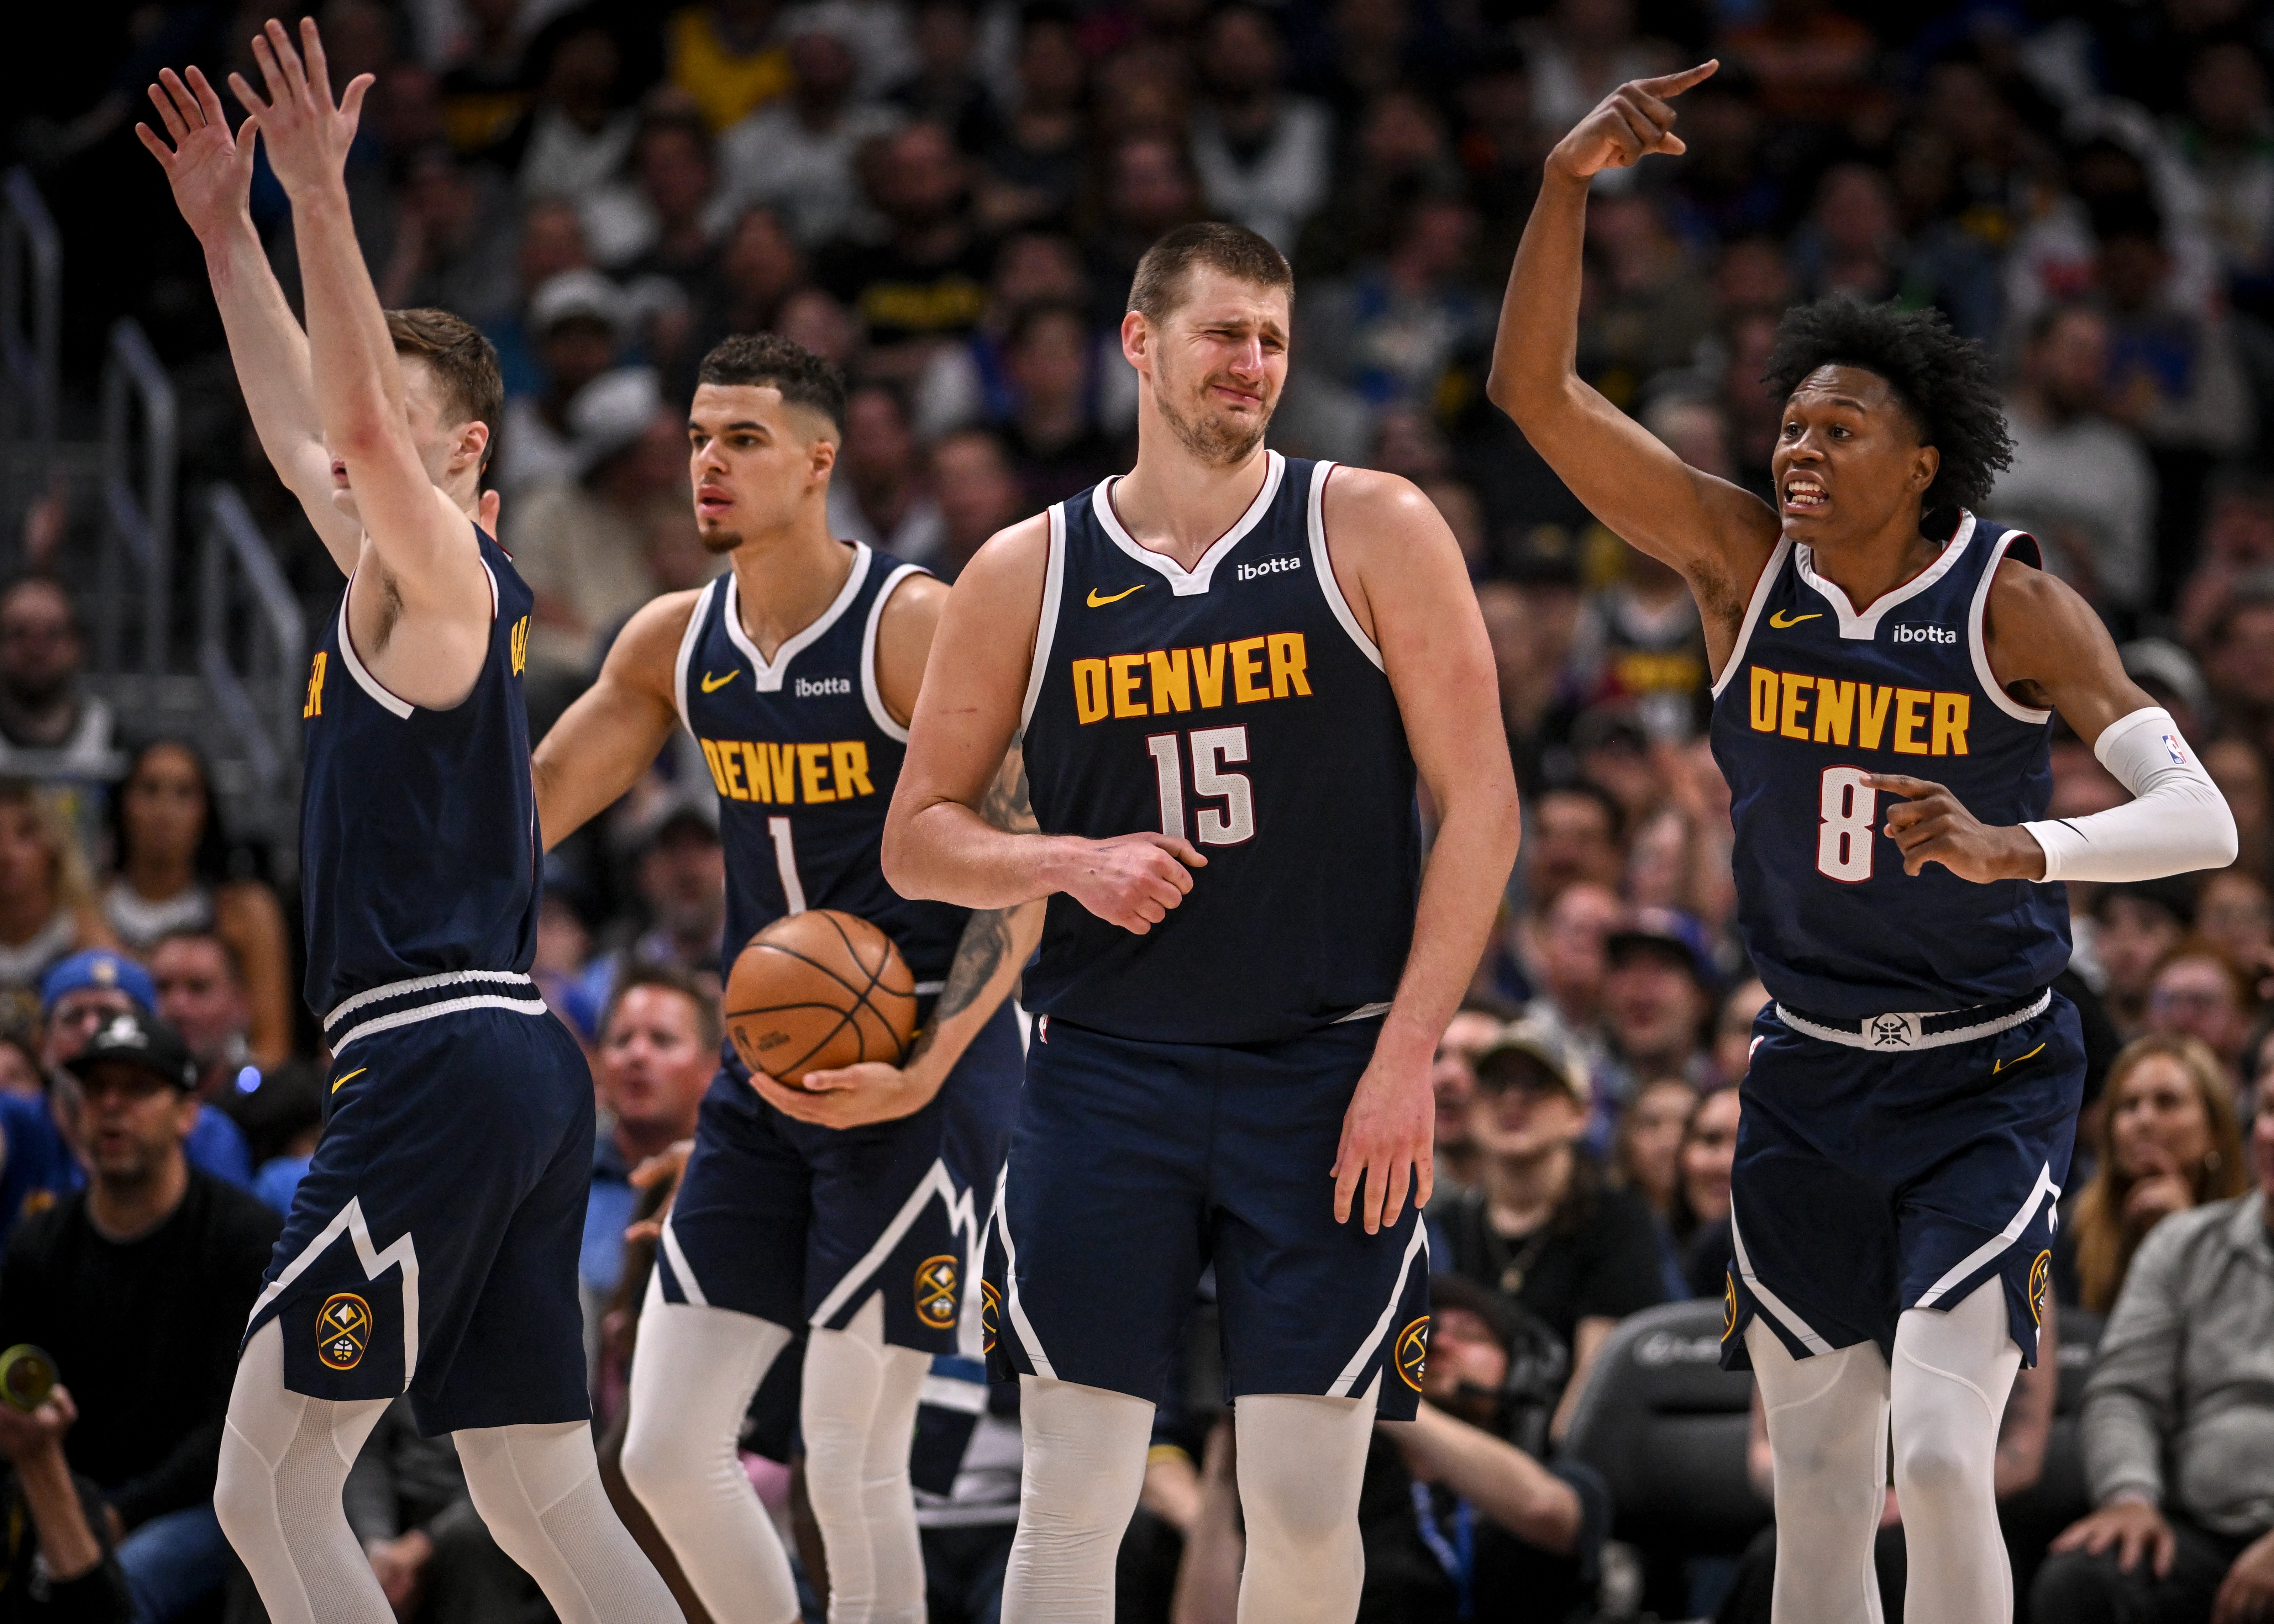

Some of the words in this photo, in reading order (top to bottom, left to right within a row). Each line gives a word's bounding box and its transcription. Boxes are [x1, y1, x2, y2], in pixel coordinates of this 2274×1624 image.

[1238, 557, 1301, 581] ibotta
[1072, 632, 1313, 725] DENVER
[1894, 624, 1957, 644] ibotta
[795, 677, 851, 697] ibotta
[1750, 665, 1971, 756] DENVER
[700, 737, 875, 804] DENVER
[1146, 724, 1256, 846] 15
[768, 816, 807, 916] 1
[1816, 765, 1878, 883] 8
